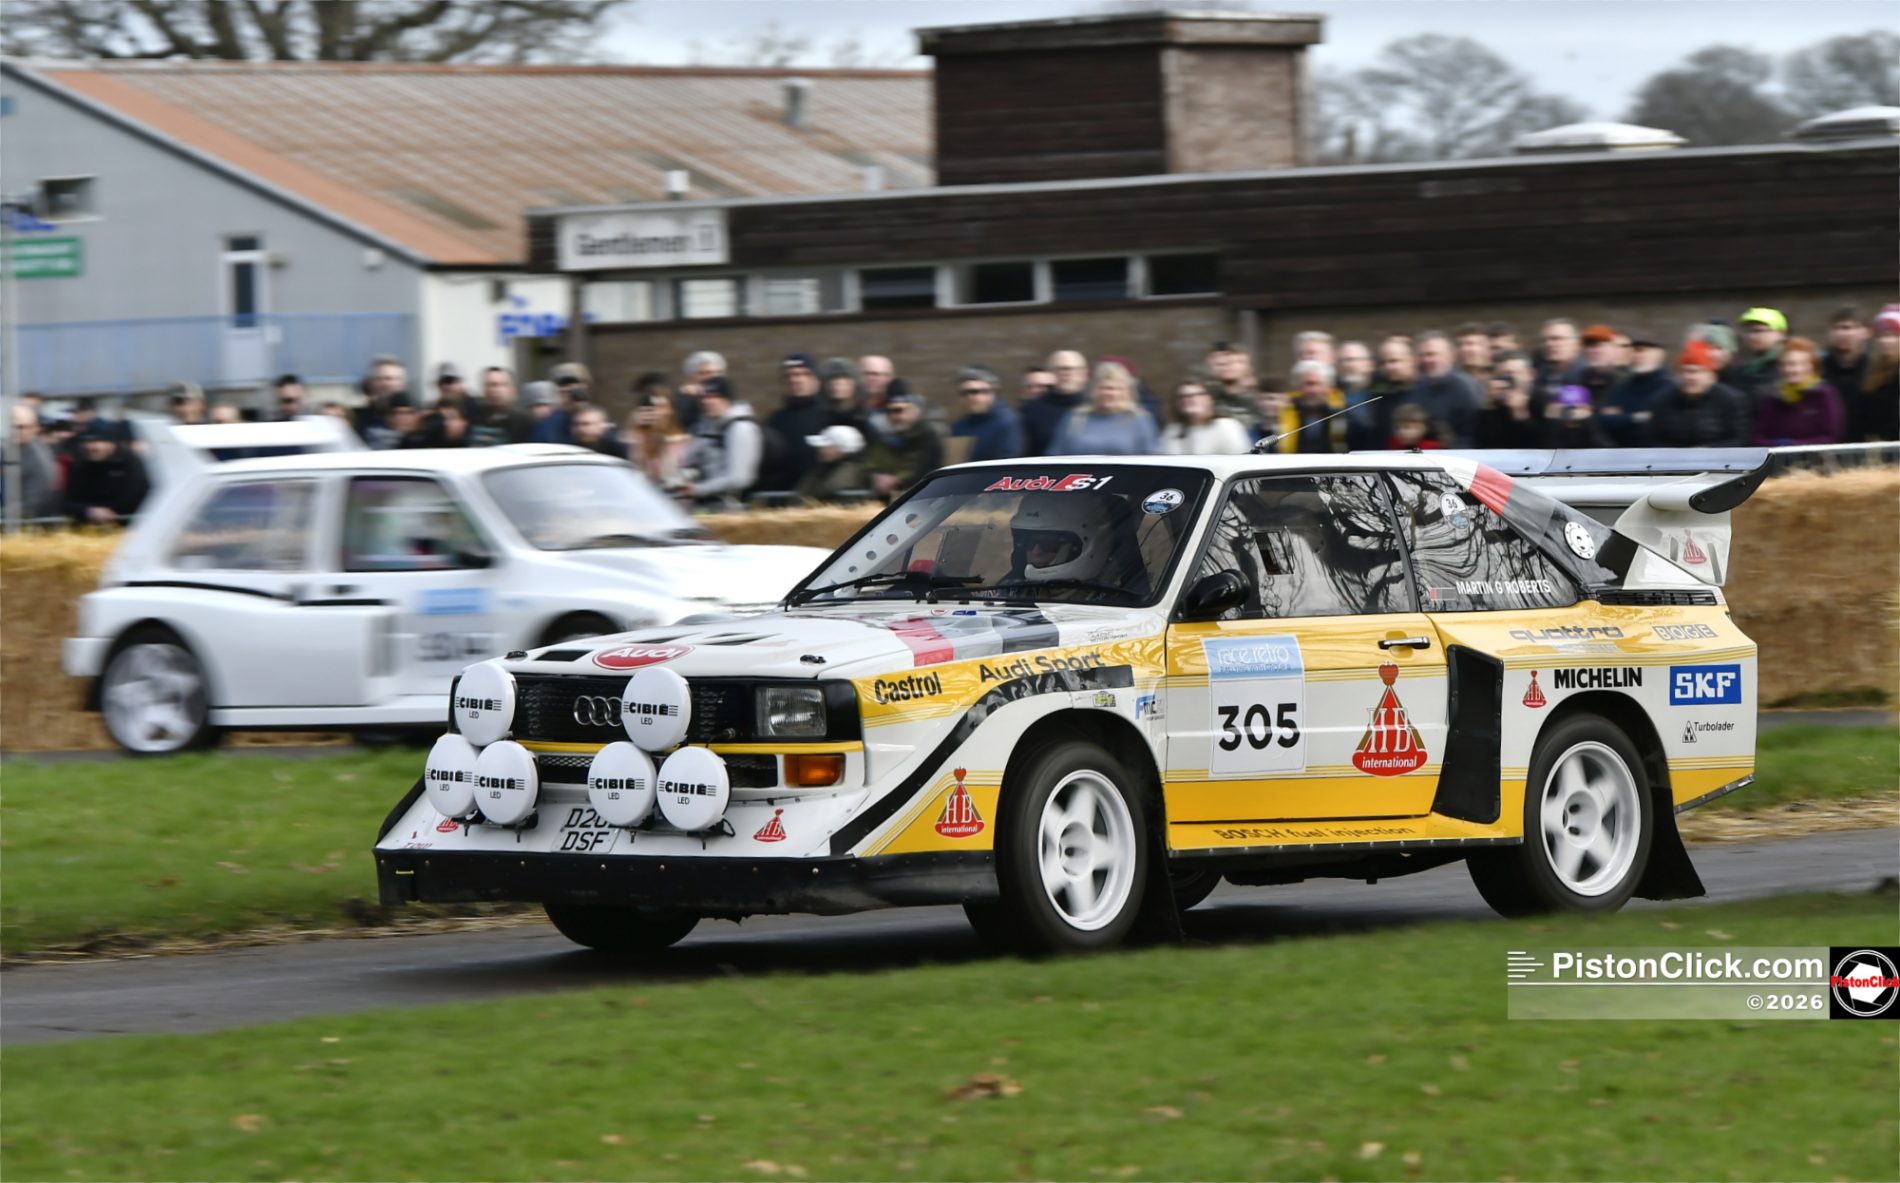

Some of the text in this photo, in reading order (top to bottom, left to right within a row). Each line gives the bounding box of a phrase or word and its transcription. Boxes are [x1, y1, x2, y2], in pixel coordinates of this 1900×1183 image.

[984, 475, 1054, 492] Audi
[1455, 579, 1551, 595] MARTIN G ROBERTS
[1509, 625, 1625, 643] quattro
[1655, 623, 1717, 641] BOGE
[1216, 643, 1290, 665] race retro
[979, 650, 1105, 683] Audi Sport
[1553, 667, 1643, 689] MICHELIN
[1674, 672, 1736, 699] SKF
[874, 671, 943, 705] Castrol
[469, 711, 480, 719] LED
[641, 717, 653, 725] LED
[1218, 703, 1300, 751] 305
[1367, 707, 1412, 753] HB
[1693, 720, 1735, 732] Turbolader
[1362, 755, 1418, 769] international
[440, 784, 450, 792] LED
[490, 791, 502, 799] LED
[677, 796, 690, 805] LED
[943, 794, 973, 824] HB
[940, 824, 978, 834] international
[1214, 826, 1416, 840] BOSCH fuel injection
[560, 831, 610, 851] DSF
